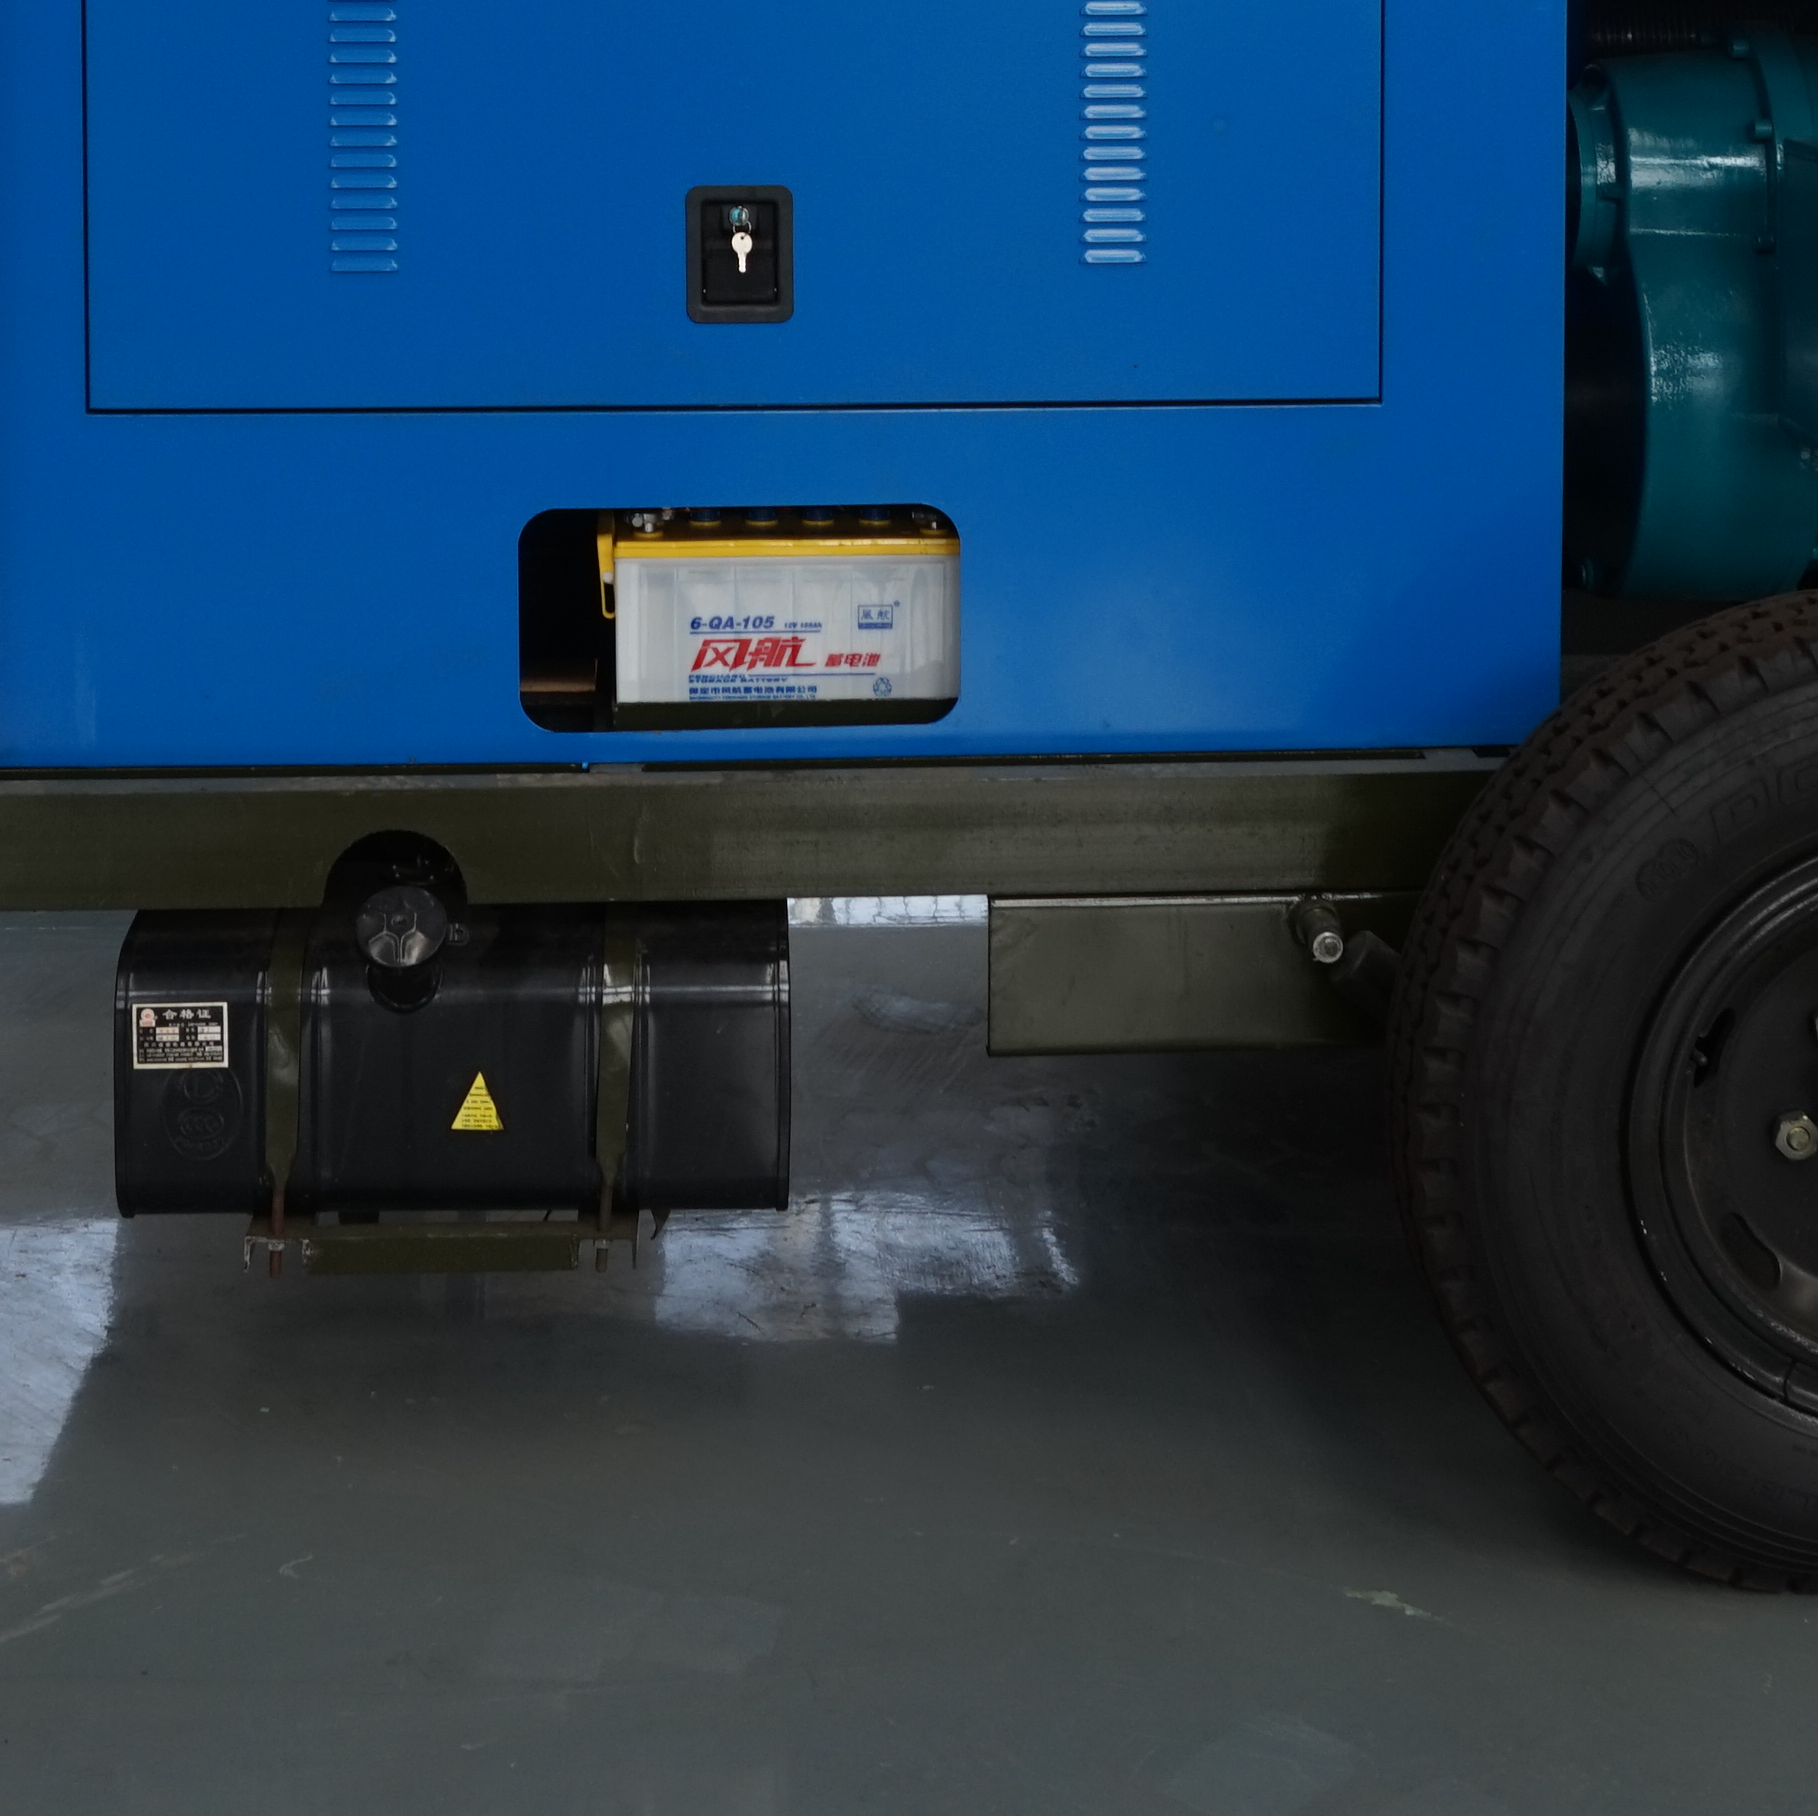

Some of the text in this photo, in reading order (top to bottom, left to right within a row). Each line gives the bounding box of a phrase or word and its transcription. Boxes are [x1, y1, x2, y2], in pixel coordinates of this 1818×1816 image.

[690, 615, 775, 630] 6-QA-105
[825, 652, 882, 668] 蓄电池
[162, 1008, 212, 1021] 合格证
